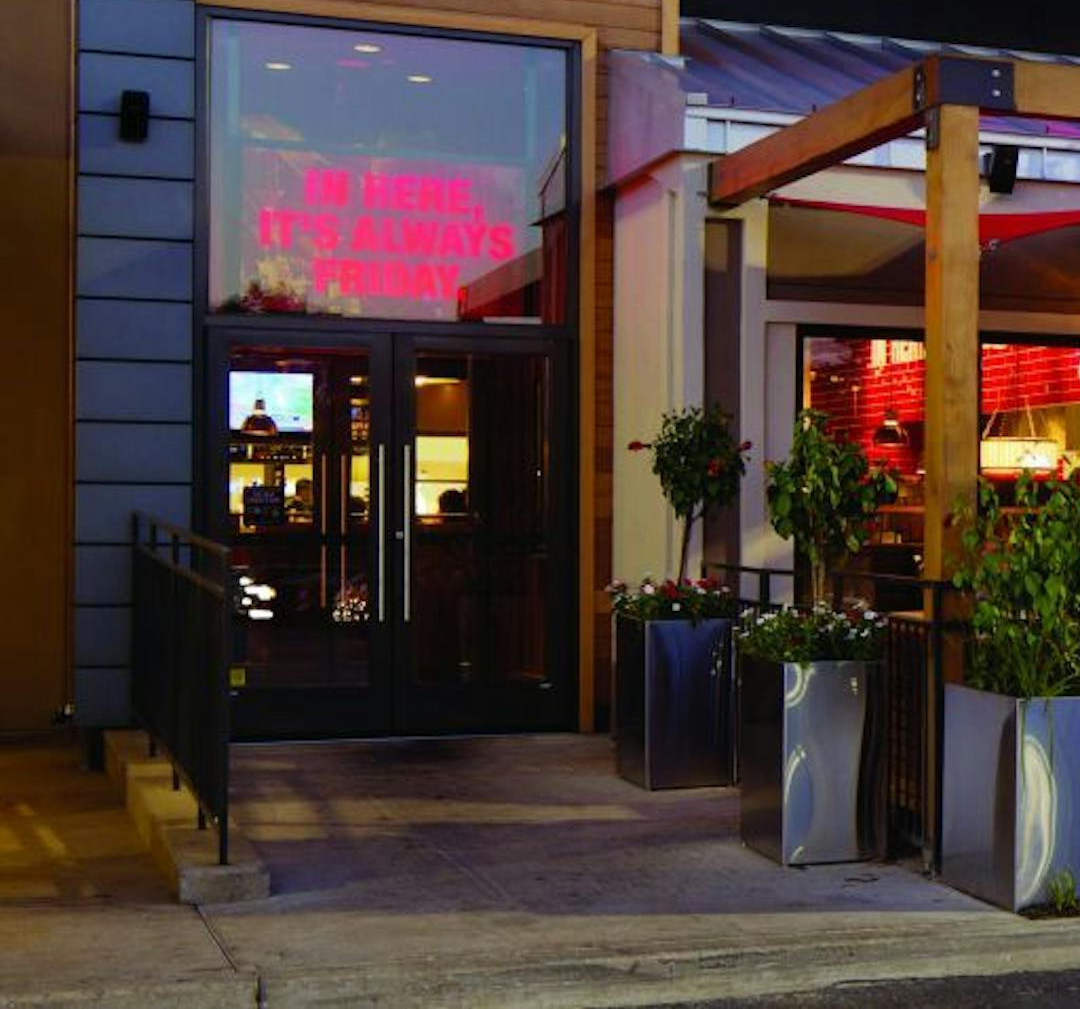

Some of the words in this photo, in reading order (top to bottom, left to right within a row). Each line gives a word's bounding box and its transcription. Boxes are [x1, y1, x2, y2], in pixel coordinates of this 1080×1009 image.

[304, 168, 349, 207] IN
[362, 171, 484, 223] HERE,
[258, 209, 340, 251] IT'S
[351, 216, 514, 261] ALWAYS
